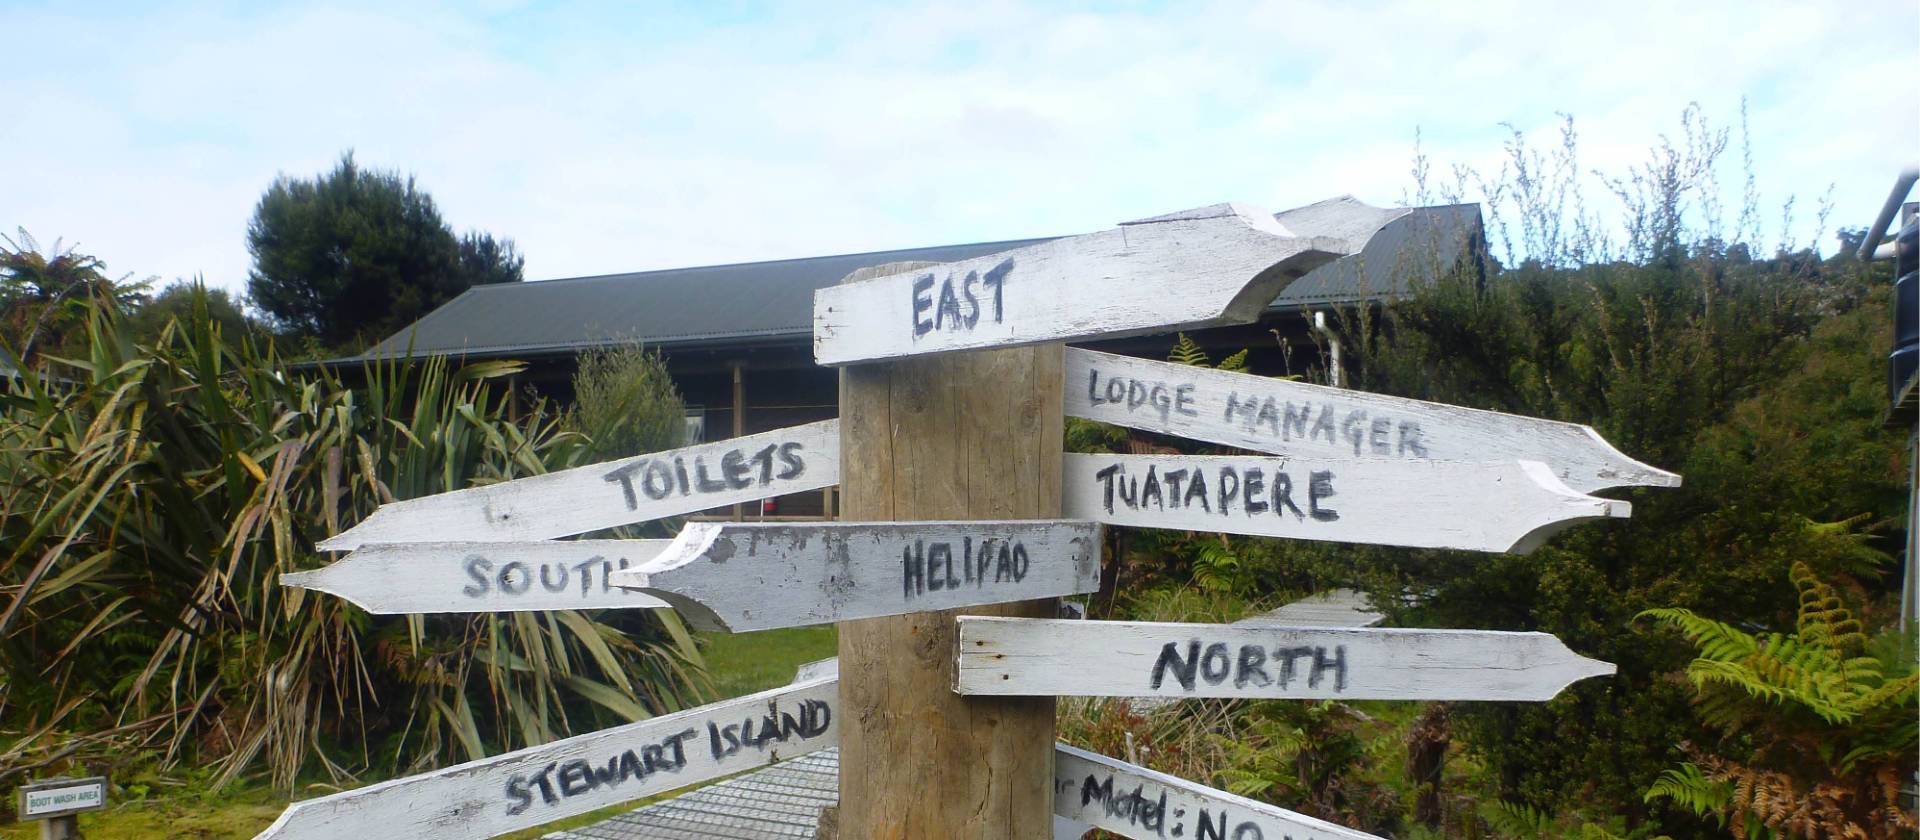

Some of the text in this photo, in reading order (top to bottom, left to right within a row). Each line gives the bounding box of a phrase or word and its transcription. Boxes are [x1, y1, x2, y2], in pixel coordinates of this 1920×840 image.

[912, 256, 1015, 337] EAST
[1088, 368, 1428, 458] LODGE MANAGER
[604, 441, 805, 511] TOILETS
[1096, 463, 1339, 522] TUATAPERE
[903, 536, 1029, 598] HELIPAD
[1151, 638, 1348, 692] NORTH
[30, 791, 98, 808] BOOT WASH AREA
[505, 728, 699, 816] STEWART
